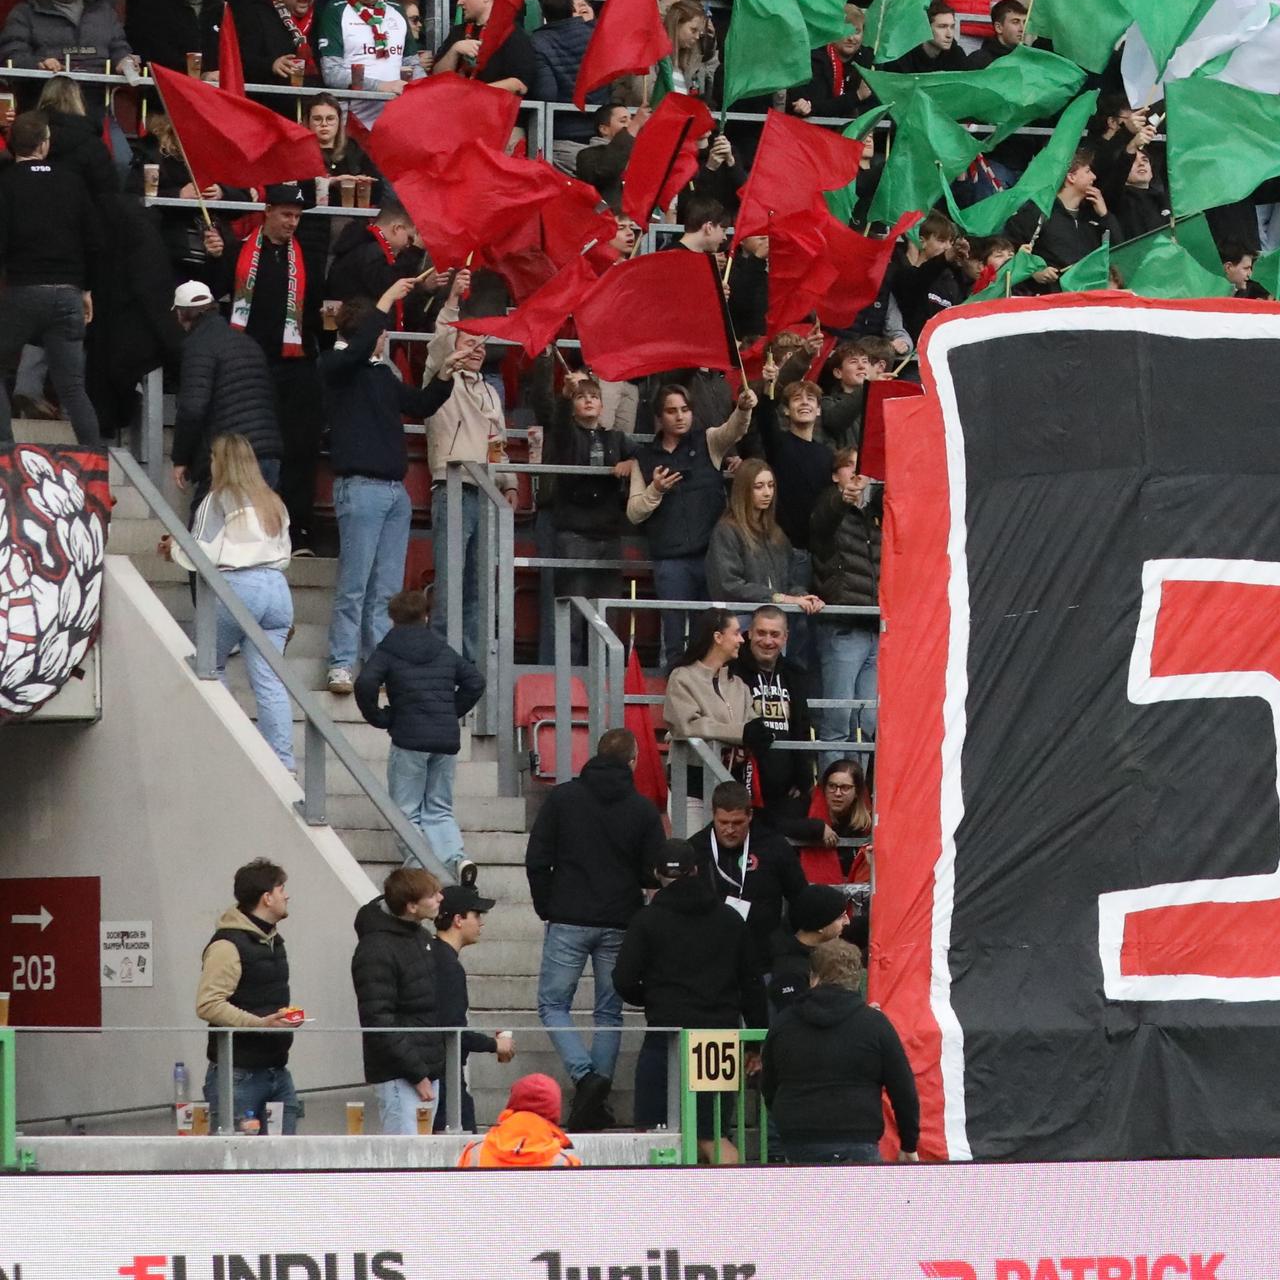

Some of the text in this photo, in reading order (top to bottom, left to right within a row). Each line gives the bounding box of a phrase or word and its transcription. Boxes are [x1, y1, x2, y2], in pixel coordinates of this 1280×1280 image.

[763, 721, 789, 735] ONDON
[12, 955, 55, 990] 203
[692, 1042, 736, 1081] 105
